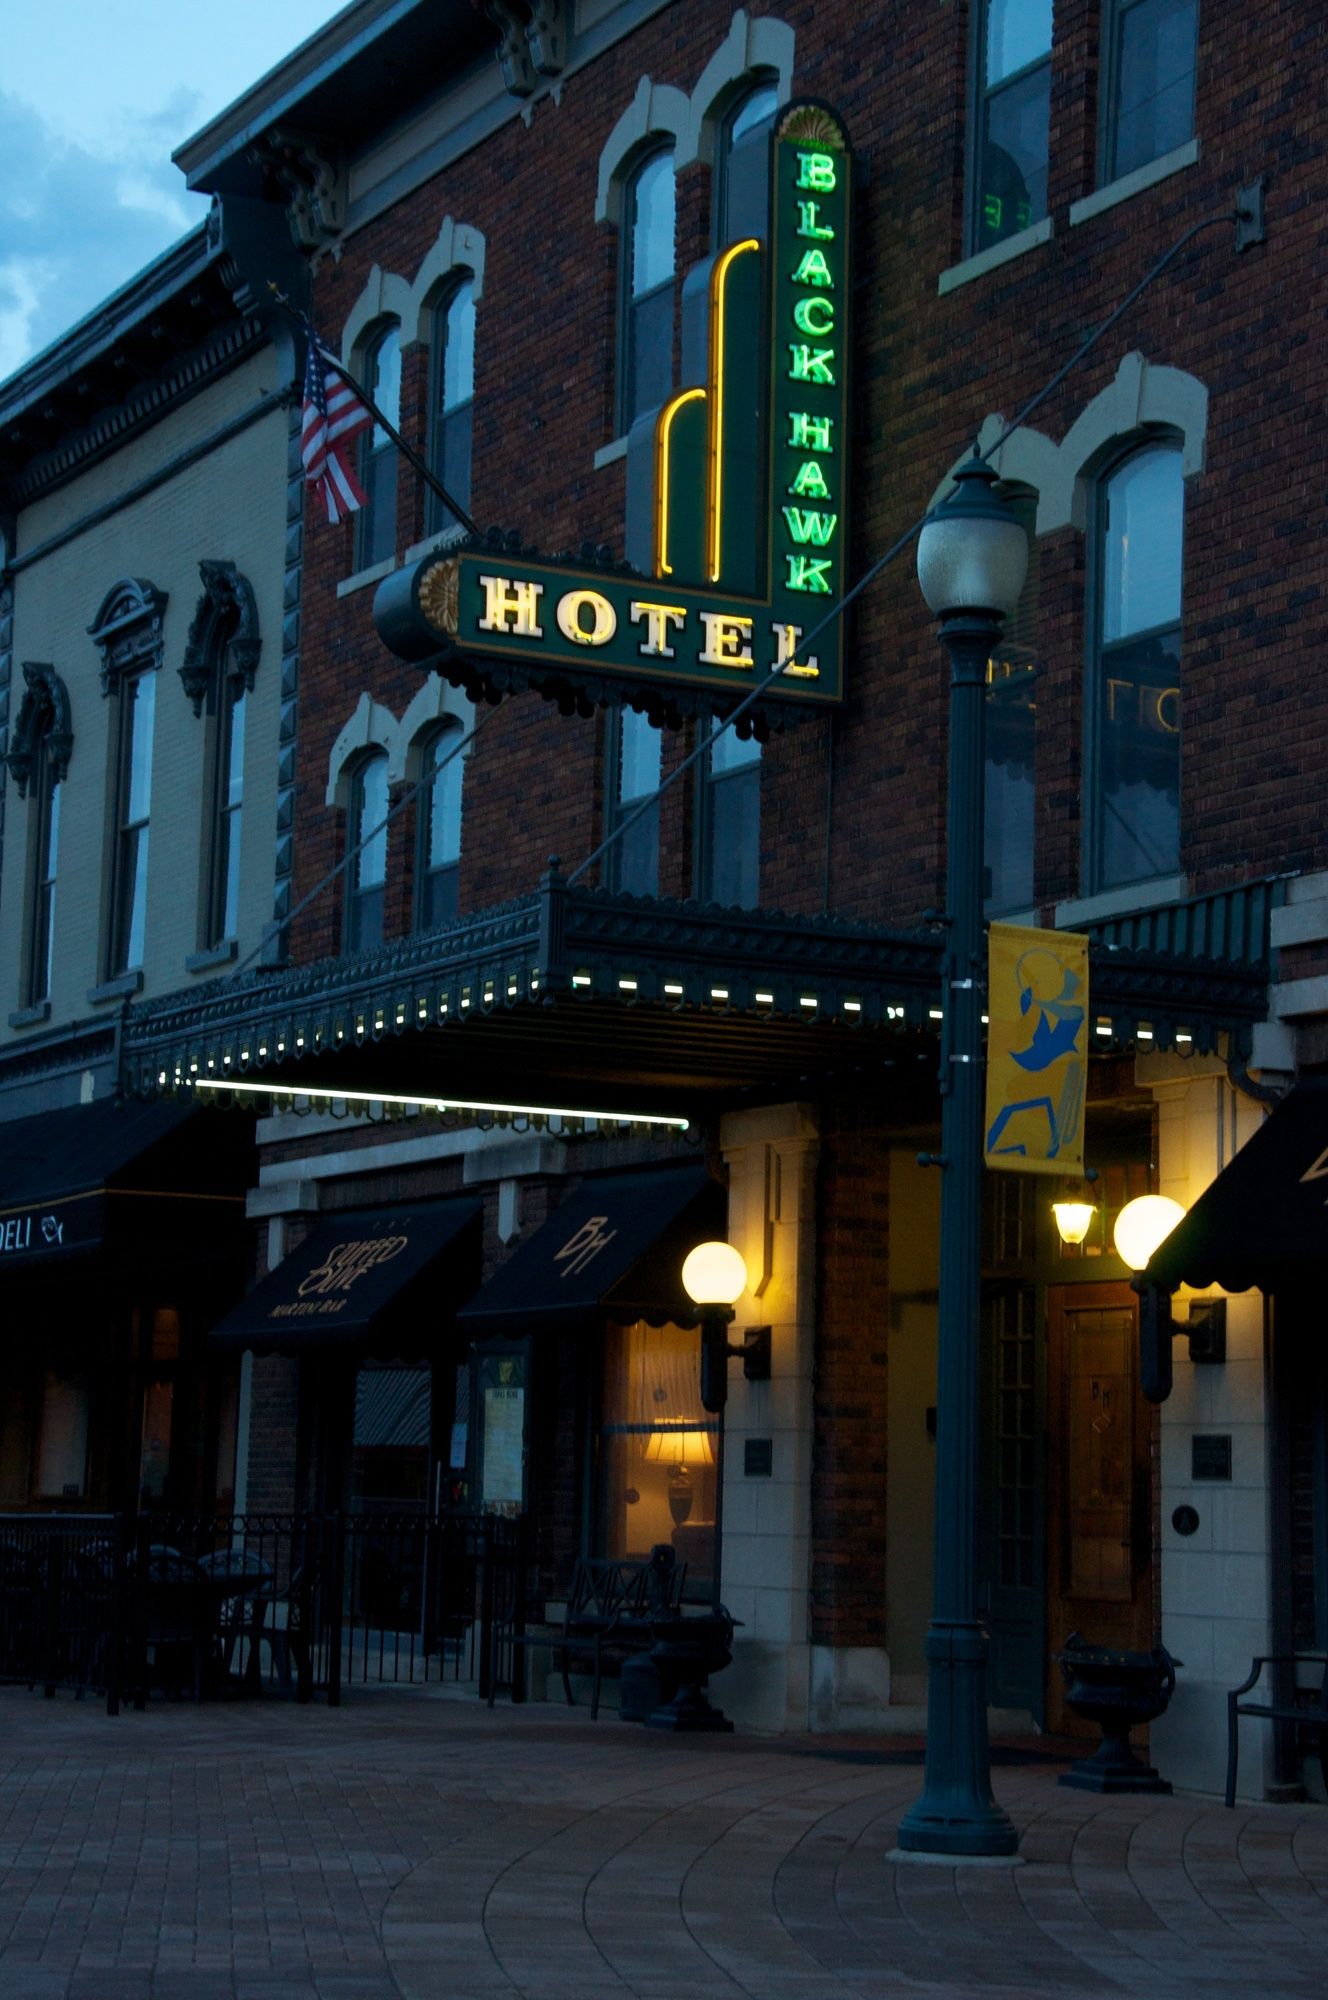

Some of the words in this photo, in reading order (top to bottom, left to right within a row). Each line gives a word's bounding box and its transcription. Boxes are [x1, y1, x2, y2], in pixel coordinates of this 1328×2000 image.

[478, 574, 820, 678] HOTEL
[309, 1235, 408, 1274] STUFFED
[297, 1262, 374, 1297] OLIVE
[317, 1298, 348, 1313] BAR
